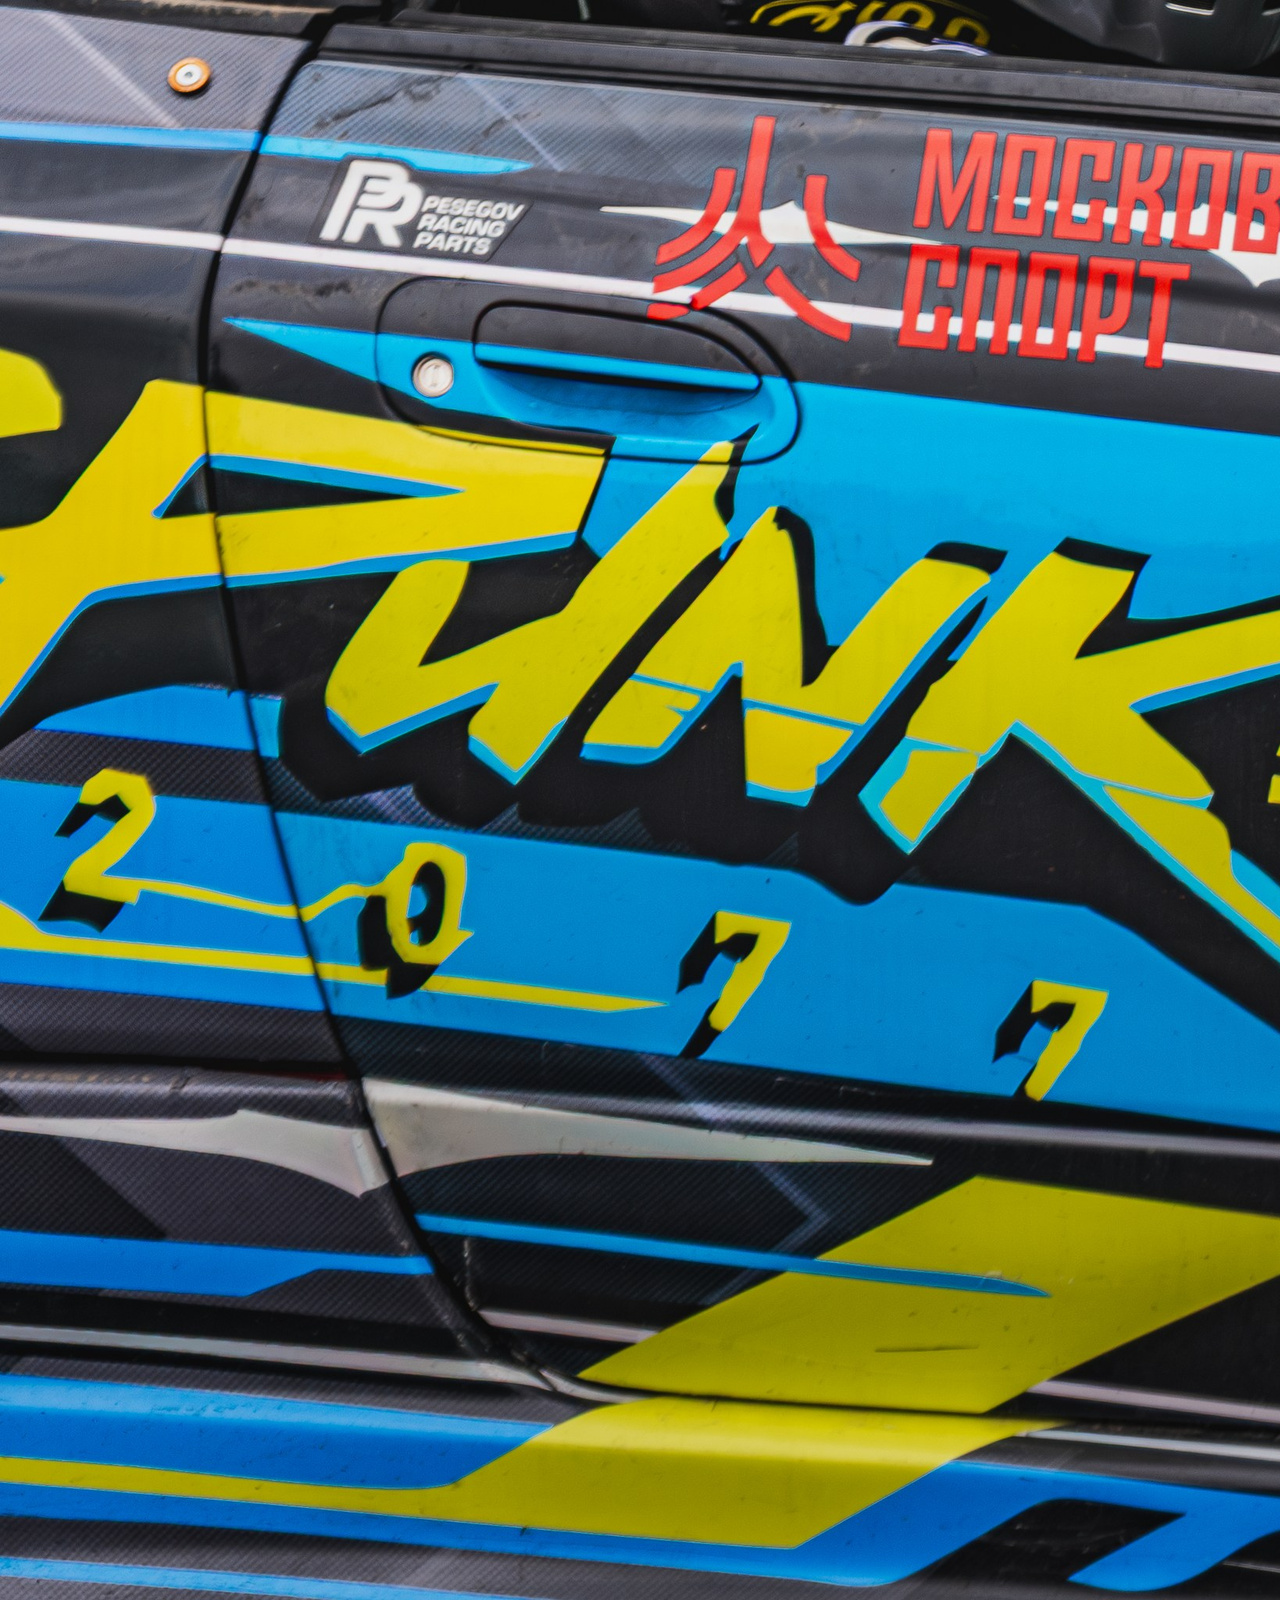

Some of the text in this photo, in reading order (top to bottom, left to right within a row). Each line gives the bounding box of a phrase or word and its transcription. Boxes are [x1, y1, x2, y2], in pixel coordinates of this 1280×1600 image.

[421, 195, 525, 221] PESEGOV
[416, 213, 506, 239] RACING
[412, 231, 493, 256] PARTS
[896, 242, 1191, 369] СПОРТ
